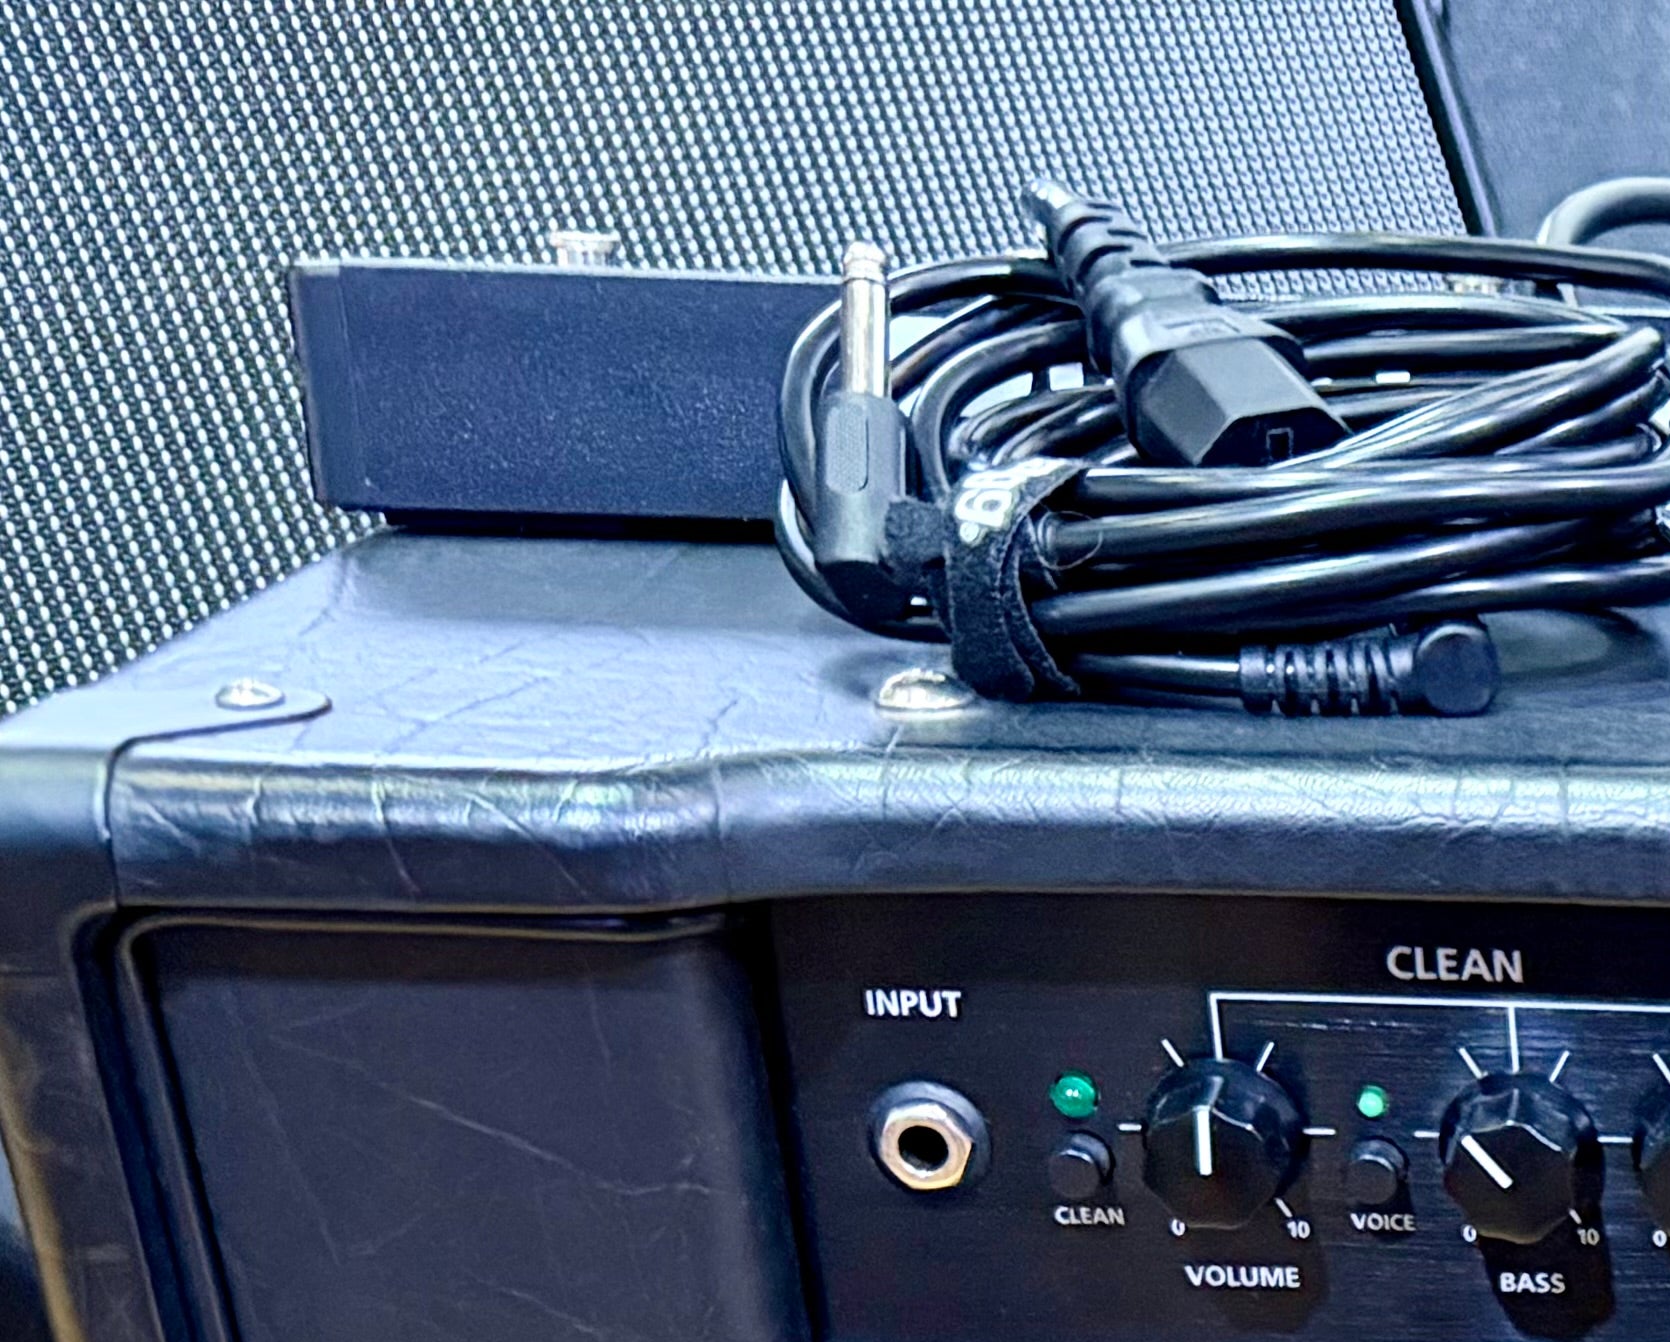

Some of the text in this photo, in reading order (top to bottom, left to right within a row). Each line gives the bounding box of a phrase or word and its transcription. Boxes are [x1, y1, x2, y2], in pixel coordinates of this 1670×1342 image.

[1386, 945, 1523, 983] CLEAN
[865, 989, 962, 1018] INPUT
[1054, 1205, 1125, 1225] CLEAN
[1350, 1212, 1416, 1231] VOICE
[1170, 1218, 1186, 1236] 0
[1286, 1220, 1311, 1239] 10
[1462, 1224, 1477, 1243] 0
[1576, 1228, 1600, 1246] 10
[1652, 1229, 1668, 1248] 0
[1184, 1264, 1301, 1288] VOLUME
[1499, 1272, 1566, 1294] BASS
